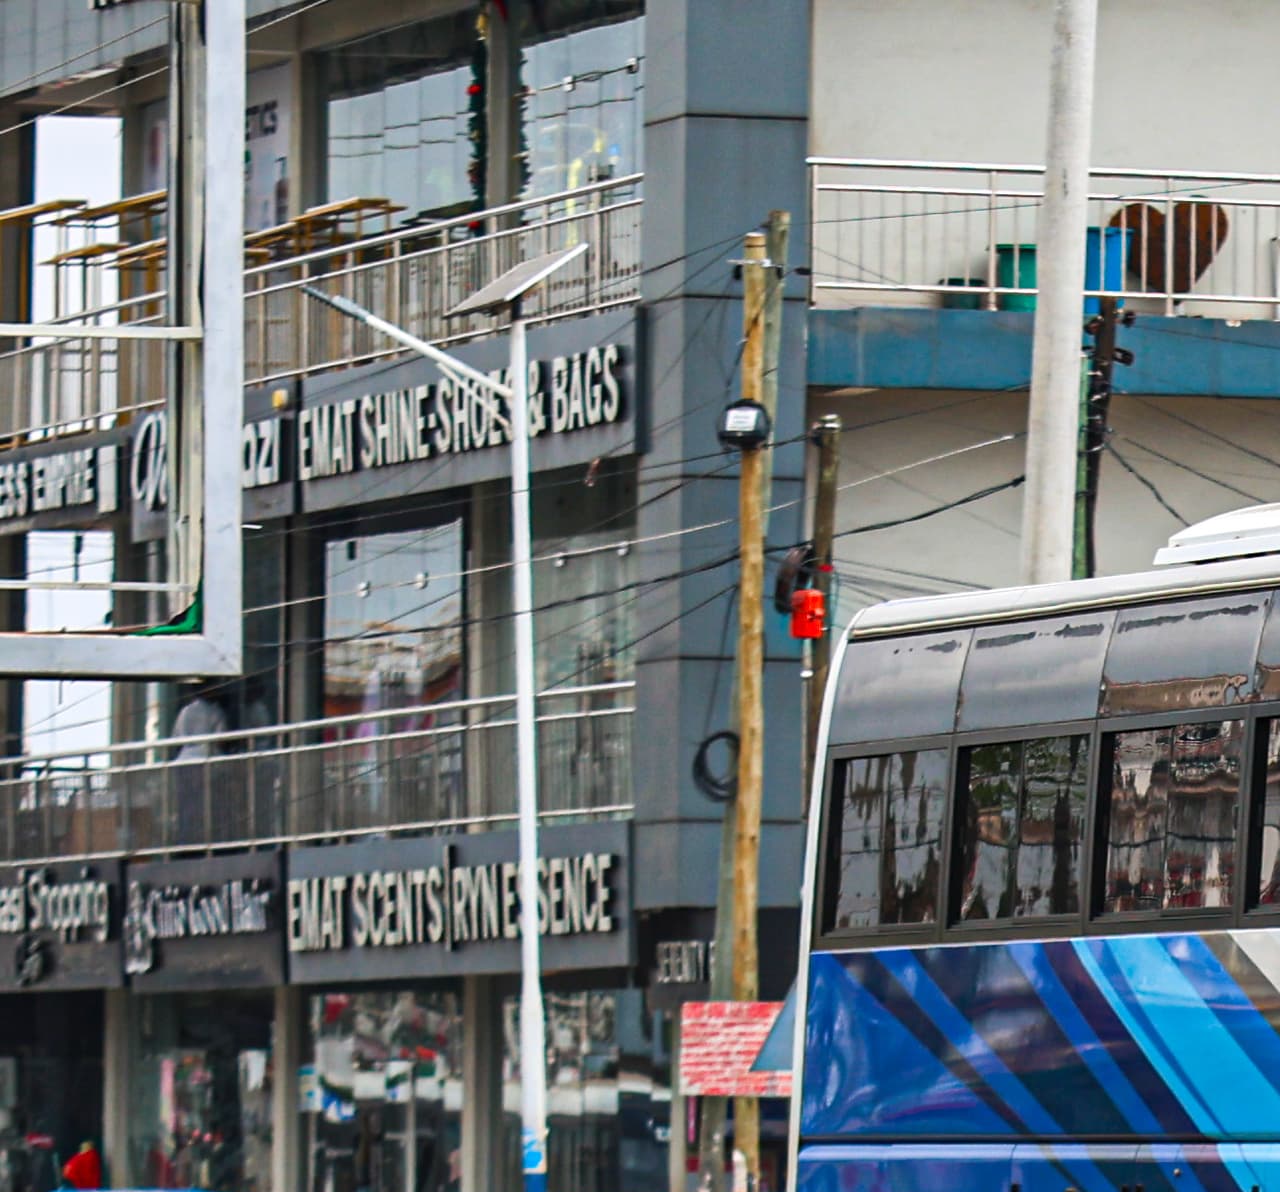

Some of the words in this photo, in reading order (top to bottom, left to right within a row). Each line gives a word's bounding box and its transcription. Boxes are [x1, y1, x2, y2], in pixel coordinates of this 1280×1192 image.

[300, 400, 356, 481] EMAT
[527, 358, 546, 438] &
[552, 343, 620, 434] BAGS
[288, 875, 348, 951] EMAT
[353, 866, 446, 947] SCENTS
[453, 862, 499, 942] RYN
[503, 853, 613, 939] ESENCE
